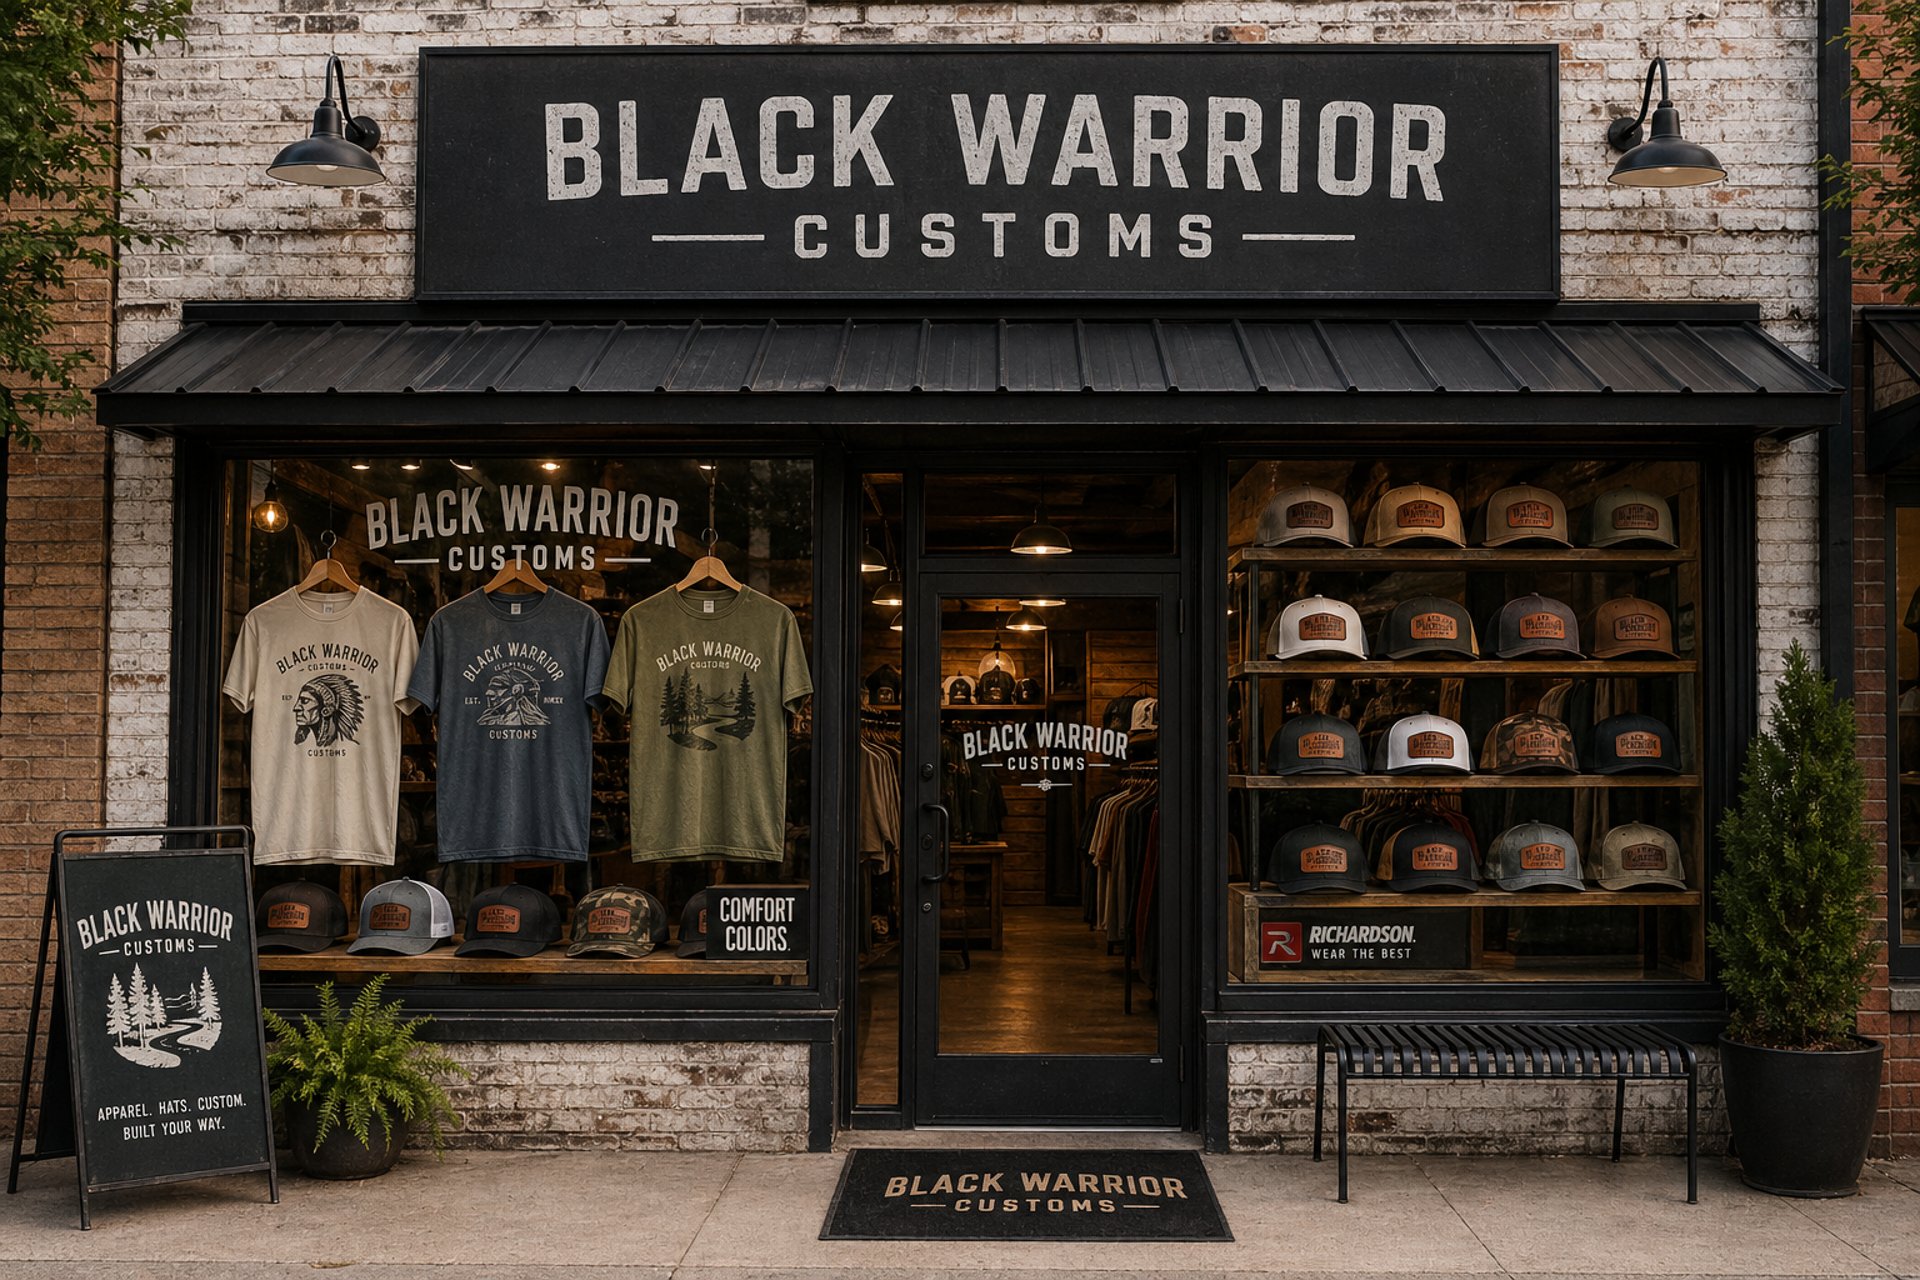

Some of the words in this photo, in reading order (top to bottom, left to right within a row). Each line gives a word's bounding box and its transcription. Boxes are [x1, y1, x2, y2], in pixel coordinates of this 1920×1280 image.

[544, 93, 894, 201] BLACK
[950, 93, 1447, 202] WARRIOR
[793, 212, 1213, 259] CUSTOMS
[365, 486, 485, 550] BLACK
[500, 485, 679, 548] WARRIOR
[448, 544, 595, 571] CUSTOMS
[275, 644, 317, 674] BLACK
[322, 643, 379, 674] WARRIOR
[463, 644, 503, 682] BLACK
[507, 642, 565, 681] WARRIOR
[656, 642, 698, 672] BLACK
[702, 641, 761, 672] WARRIOR
[963, 722, 1028, 760] BLACK
[1036, 722, 1129, 760] WARRIOR
[1007, 756, 1085, 771] CUSTOMS
[720, 897, 796, 922] COMFORT
[76, 902, 142, 950] BLACK
[146, 900, 233, 942] WARRIOR
[725, 926, 791, 951] COLORS.
[124, 938, 195, 956] CUSTOMS
[1311, 948, 1346, 959] WEAR
[1352, 948, 1375, 959] THE
[1381, 948, 1411, 959] BEST
[97, 1103, 152, 1121] APPAREL.
[159, 1099, 191, 1115] HATS.
[197, 1093, 246, 1111] CUSTOM.
[123, 1124, 156, 1140] BUILT
[161, 1119, 192, 1135] YOUR
[197, 1116, 225, 1131] WAY.
[884, 1172, 1005, 1198] BLACK
[1020, 1172, 1188, 1199] WARRIOR
[954, 1199, 1116, 1213] CUSTOMS
